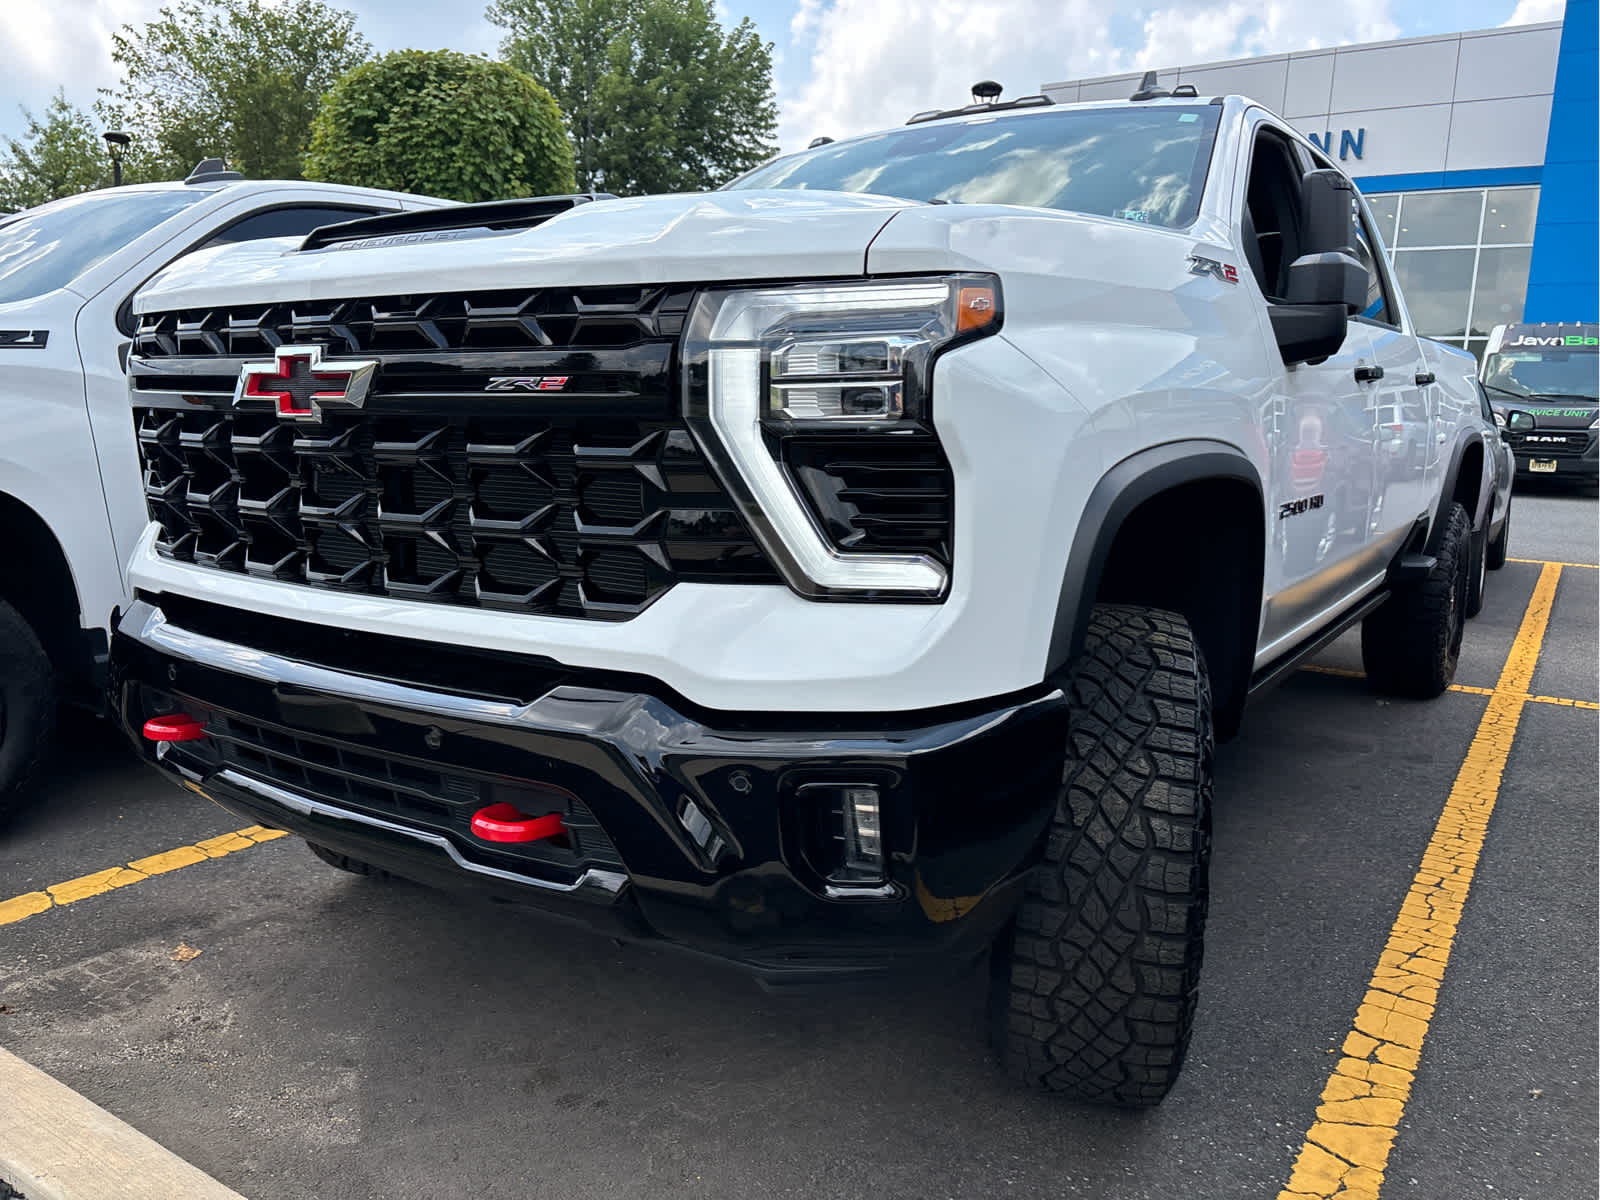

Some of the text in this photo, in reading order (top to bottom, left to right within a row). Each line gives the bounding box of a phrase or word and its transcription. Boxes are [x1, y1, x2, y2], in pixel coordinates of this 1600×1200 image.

[337, 230, 466, 250] CHEVROLET
[1188, 255, 1239, 285] ZR2
[485, 376, 569, 391] ZR2
[1525, 408, 1591, 417] RVICE UNIT
[1279, 494, 1324, 520] 2500 HD
